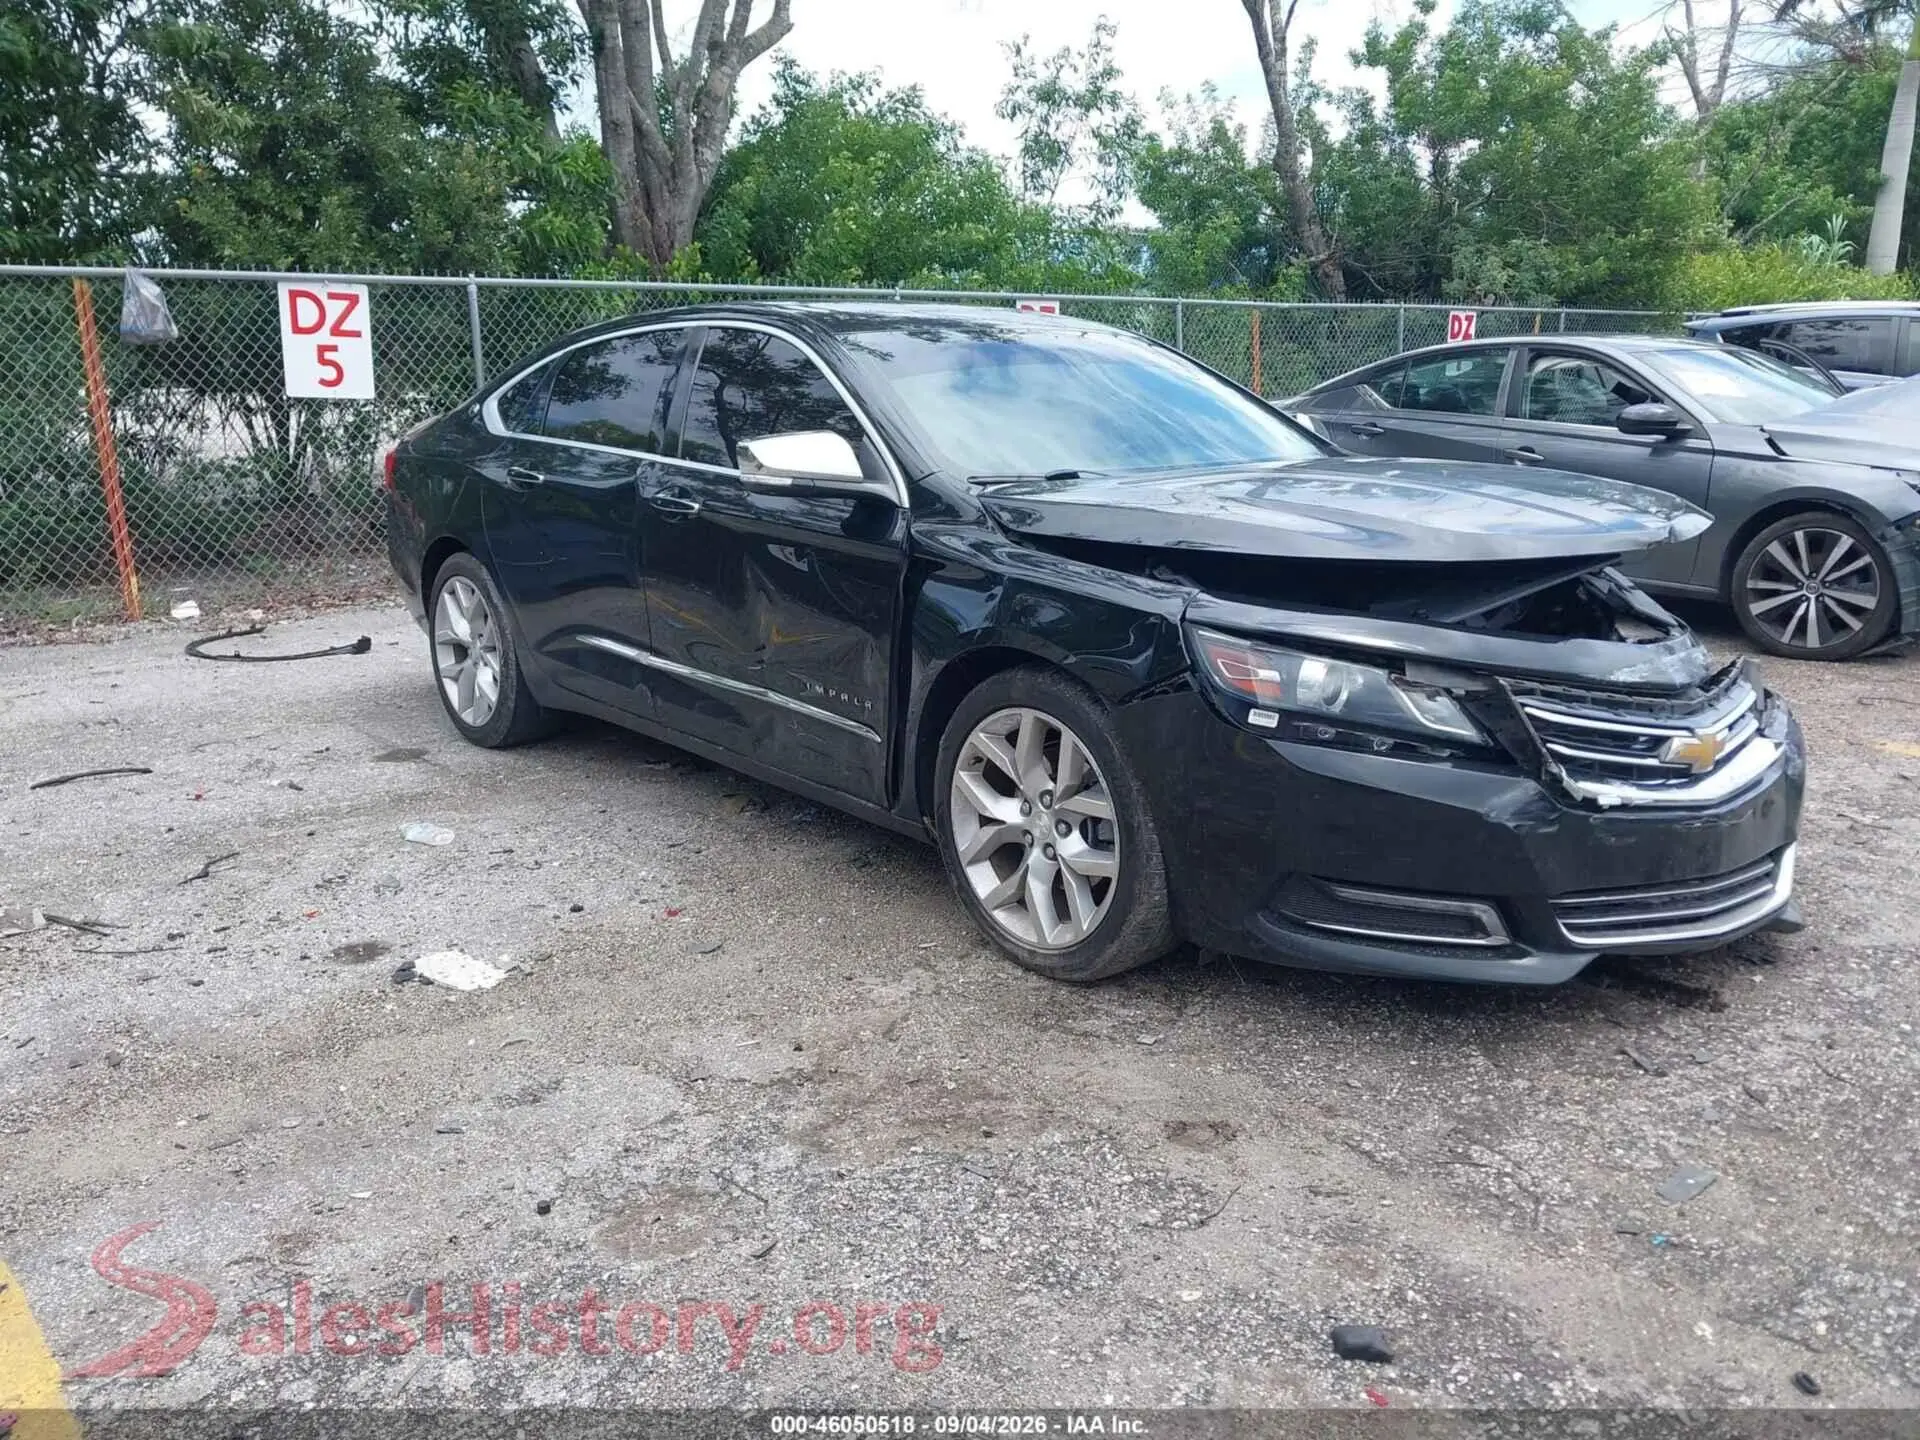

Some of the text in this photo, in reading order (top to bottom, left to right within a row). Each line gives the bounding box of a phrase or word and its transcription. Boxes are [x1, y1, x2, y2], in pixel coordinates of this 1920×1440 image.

[288, 289, 362, 338] DZ
[1450, 314, 1474, 340] DZ
[317, 344, 344, 388] 5
[805, 682, 872, 711] IMPALA
